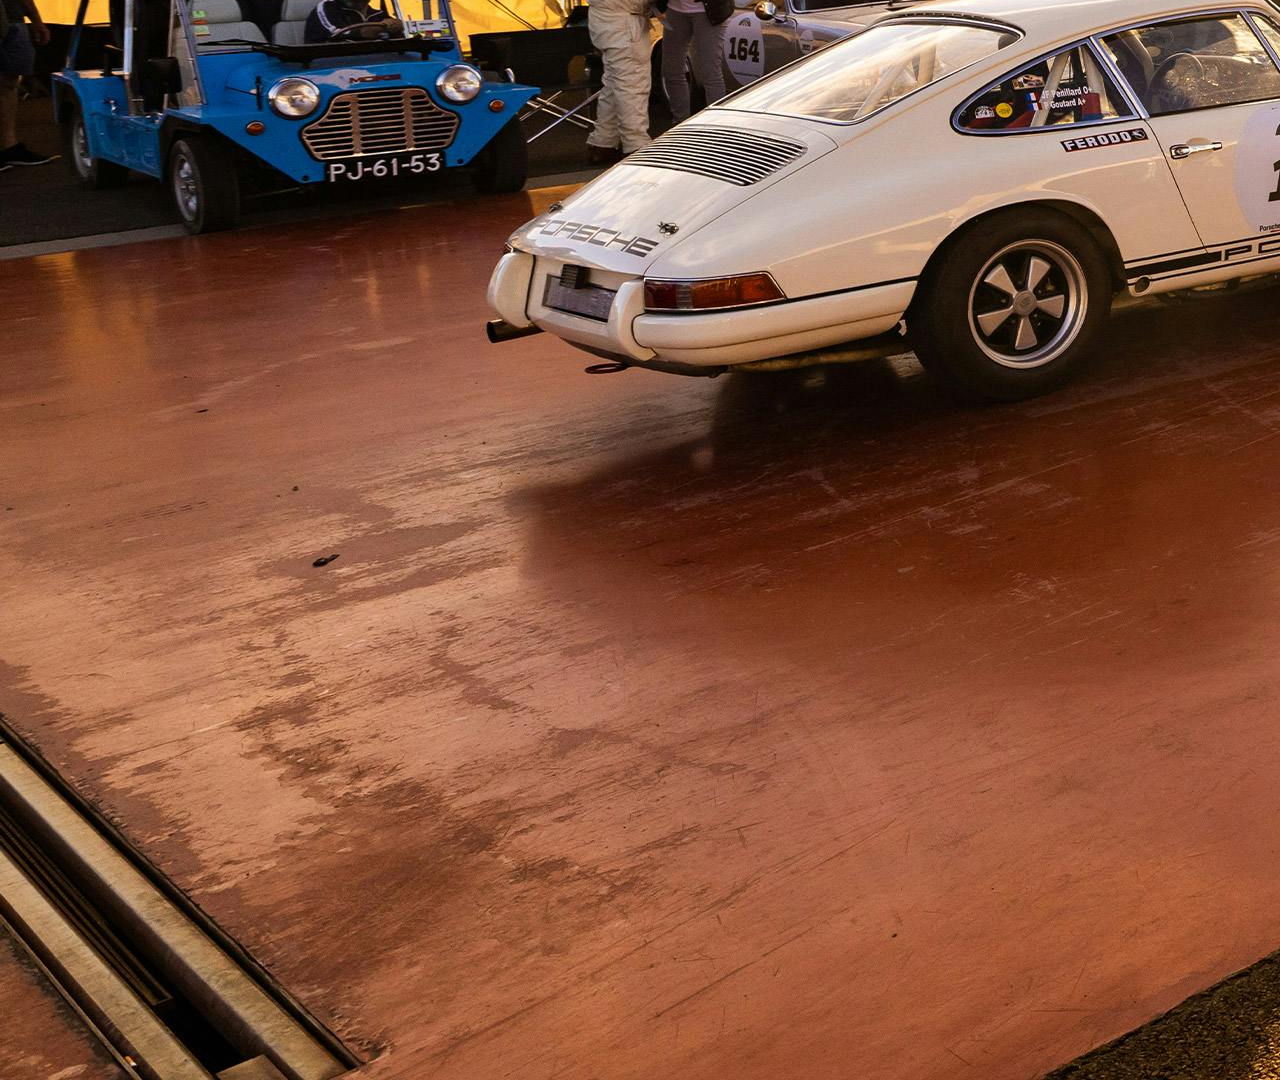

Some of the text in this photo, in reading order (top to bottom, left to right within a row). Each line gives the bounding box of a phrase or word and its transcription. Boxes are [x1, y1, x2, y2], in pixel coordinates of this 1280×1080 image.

[728, 36, 760, 63] 164
[1050, 98, 1077, 110] Goutard
[1065, 132, 1131, 150] FERODO
[329, 153, 441, 182] PJ-61-53
[1259, 222, 1280, 232] Porsche
[540, 220, 659, 258] ORSCHE
